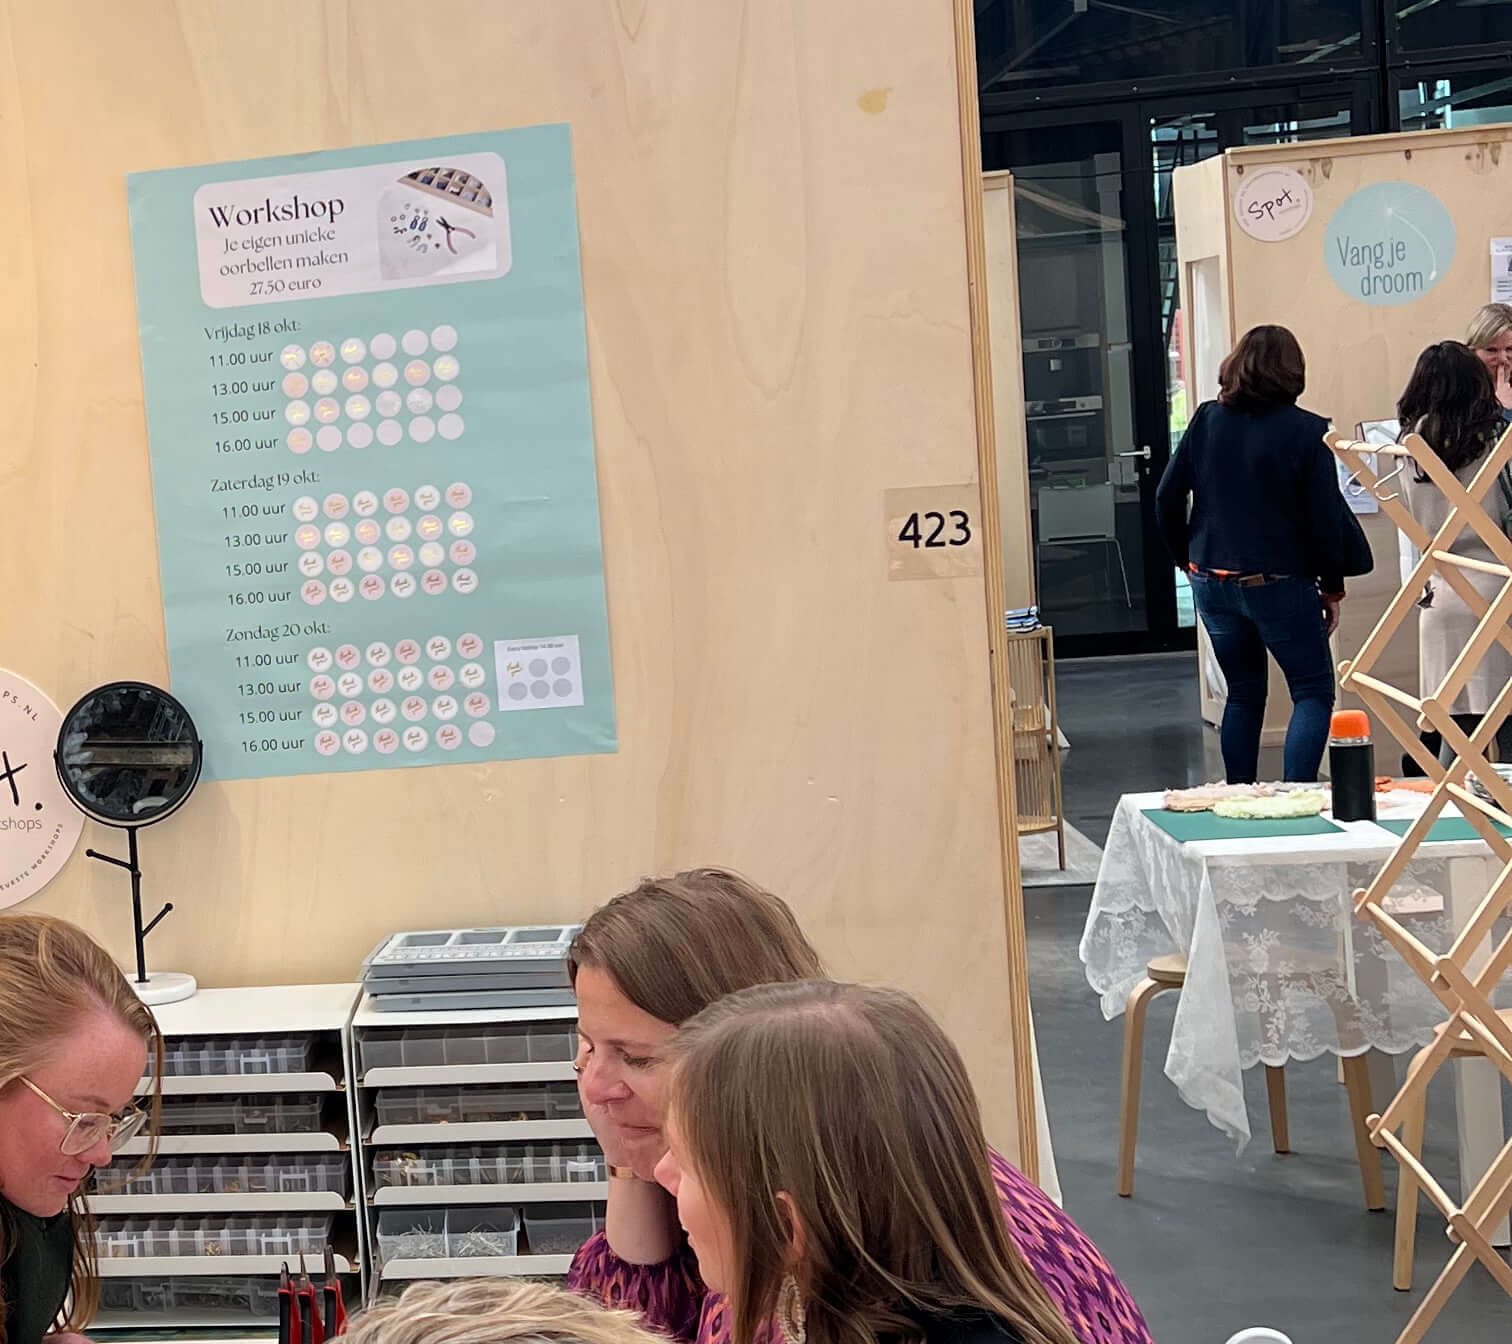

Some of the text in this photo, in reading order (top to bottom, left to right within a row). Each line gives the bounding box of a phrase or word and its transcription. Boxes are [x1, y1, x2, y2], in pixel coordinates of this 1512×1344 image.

[208, 194, 345, 228] Workshop
[223, 226, 336, 254] Je eigen unieke
[1337, 235, 1406, 270] Vang je
[219, 250, 349, 276] oorbellen maken
[289, 278, 322, 291] euro
[1360, 264, 1424, 296] droom
[204, 322, 256, 343] Vrijdag
[258, 322, 271, 336] 18
[209, 351, 274, 368] 11.00 uur
[212, 380, 276, 396] 13.00 uur
[212, 409, 276, 425] 15.00 uur
[215, 438, 279, 453] 16.00 uur
[210, 474, 275, 493] Zaterdag
[277, 473, 290, 487] 19
[222, 503, 286, 519] 11.00 uur
[898, 510, 972, 549] 423
[224, 533, 289, 548] 13.00 uur
[225, 562, 289, 577] 15.00 uur
[228, 591, 292, 606] 16.00 uur
[226, 625, 280, 642] Zondag
[282, 623, 301, 637] 20
[236, 653, 300, 668] 11.00 uur
[238, 681, 302, 697] 13.00 uur
[239, 710, 303, 725] 15.00 uur
[242, 738, 305, 753] 16.00 uur
